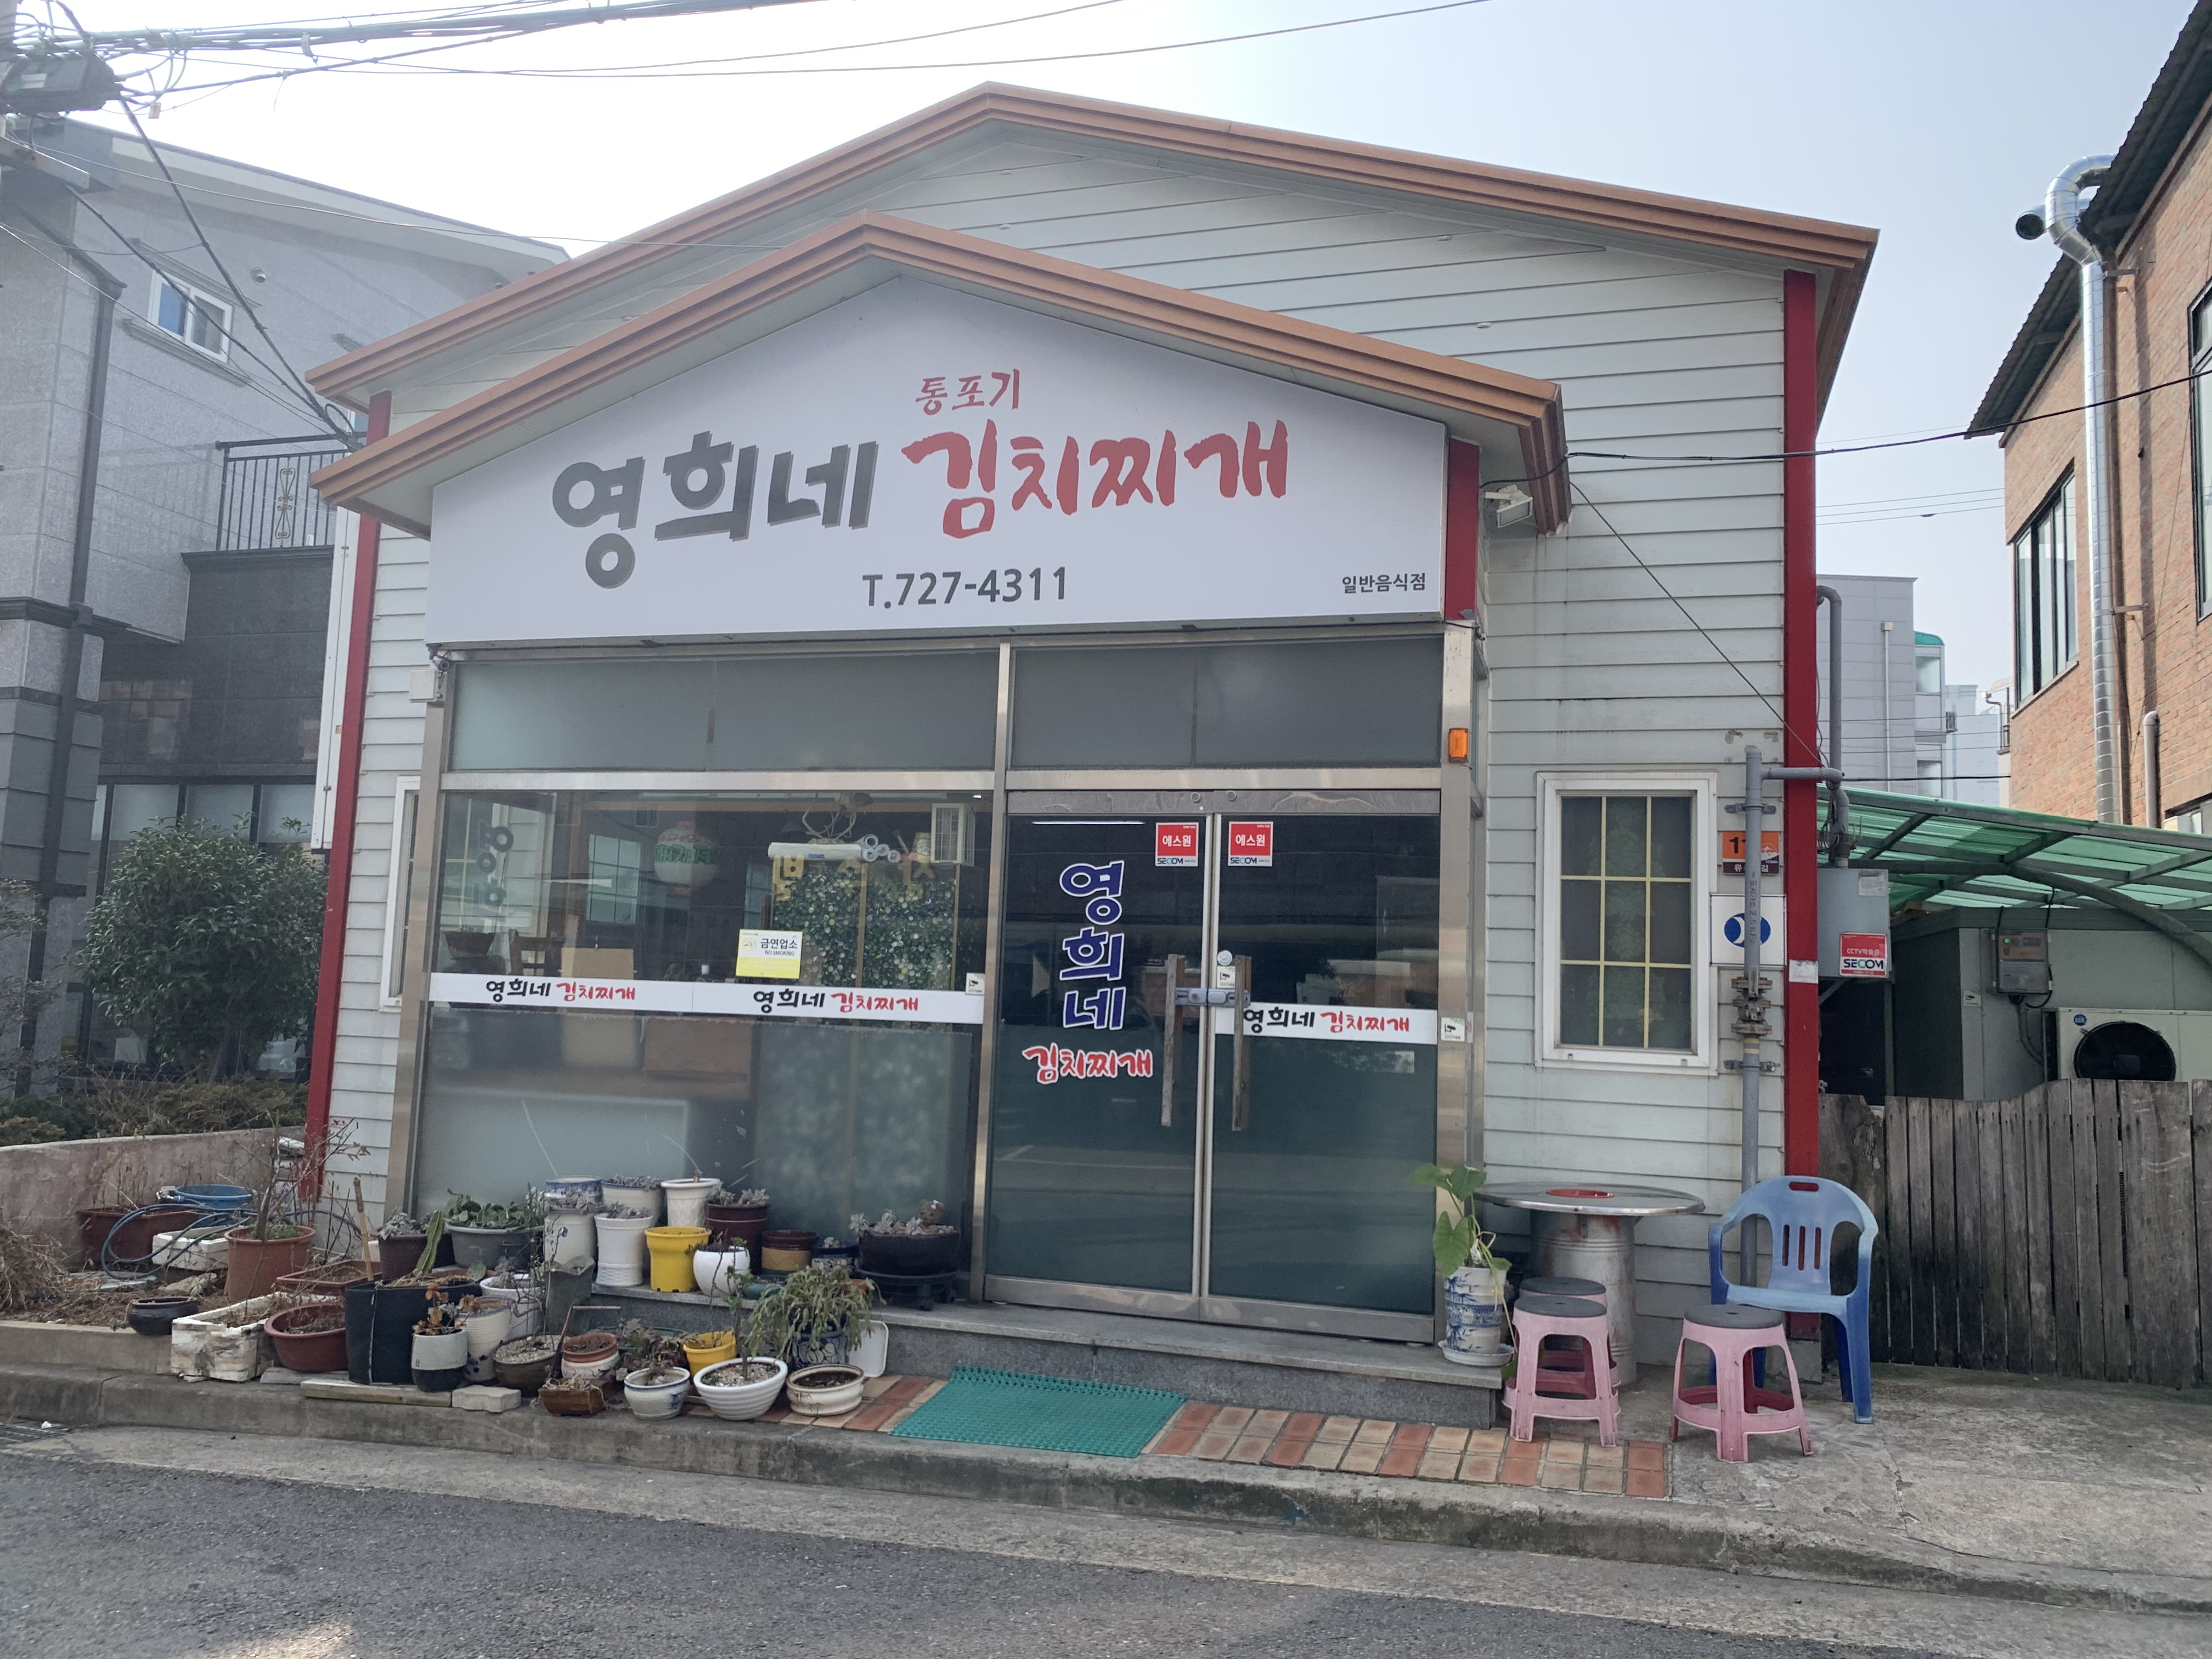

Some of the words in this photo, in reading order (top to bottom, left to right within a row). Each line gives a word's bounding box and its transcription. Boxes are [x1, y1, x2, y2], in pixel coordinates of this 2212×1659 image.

[916, 369, 1020, 410] 통포기
[552, 431, 878, 590] 영희네
[901, 418, 1288, 539] 김치찌개
[862, 566, 1066, 610] T.727-4311
[1342, 572, 1426, 594] 일반음식점
[1162, 835, 1192, 847] 에스원
[1235, 834, 1266, 847] 에스원
[1729, 837, 1746, 854] 1
[1157, 857, 1183, 865] SECOM
[760, 938, 798, 949] 금연업소
[1059, 860, 1125, 1030] 영희네
[1843, 958, 1884, 969] SECOM
[486, 978, 551, 1002] 영희네
[556, 983, 636, 1002] 김치찌개
[753, 988, 825, 1014] 영희네
[831, 992, 919, 1012] 김치찌개
[1244, 1006, 1315, 1034] 영희네
[1321, 1011, 1410, 1033] 김치찌개
[1023, 1043, 1153, 1084] 김치찌개
